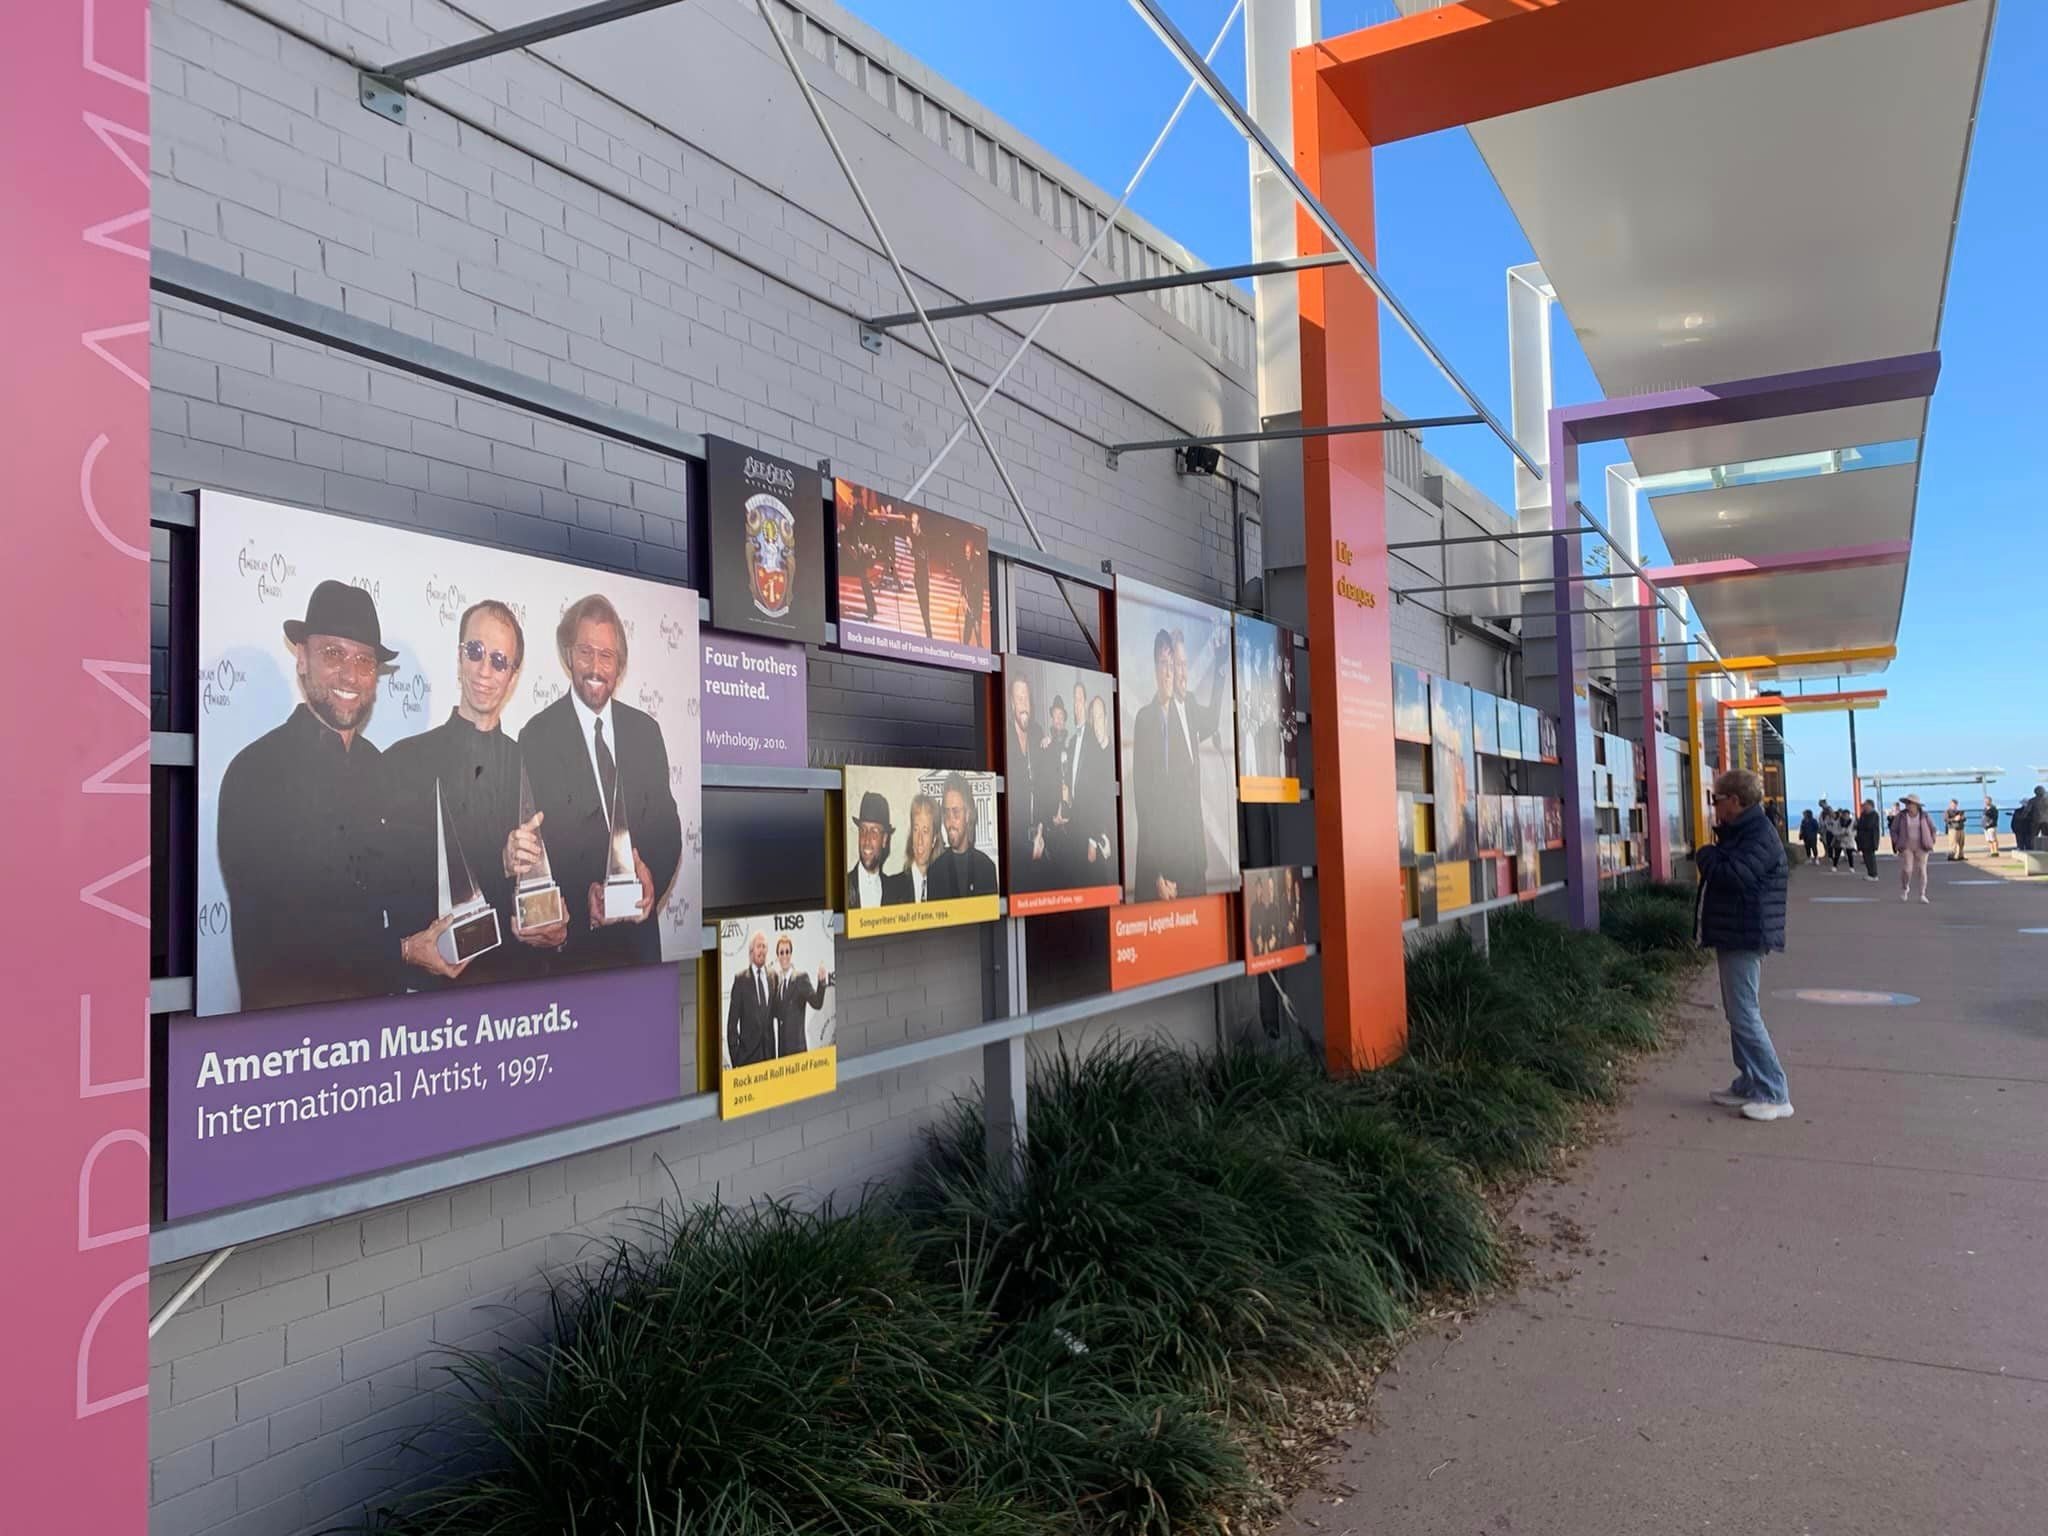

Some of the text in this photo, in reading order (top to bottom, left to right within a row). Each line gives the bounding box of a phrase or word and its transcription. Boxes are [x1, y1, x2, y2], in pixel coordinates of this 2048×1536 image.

[705, 646, 797, 677] Four brothers
[705, 679, 769, 700] reunited.
[706, 729, 787, 751] Mythology, 2010.
[1115, 919, 1148, 937] Grammy
[1148, 914, 1174, 935] Legend
[196, 1002, 579, 1089] American Music Awards.
[732, 1058, 830, 1088] Rock and Roll Hall of Fame,
[197, 1053, 553, 1140] International Artist, 1997.
